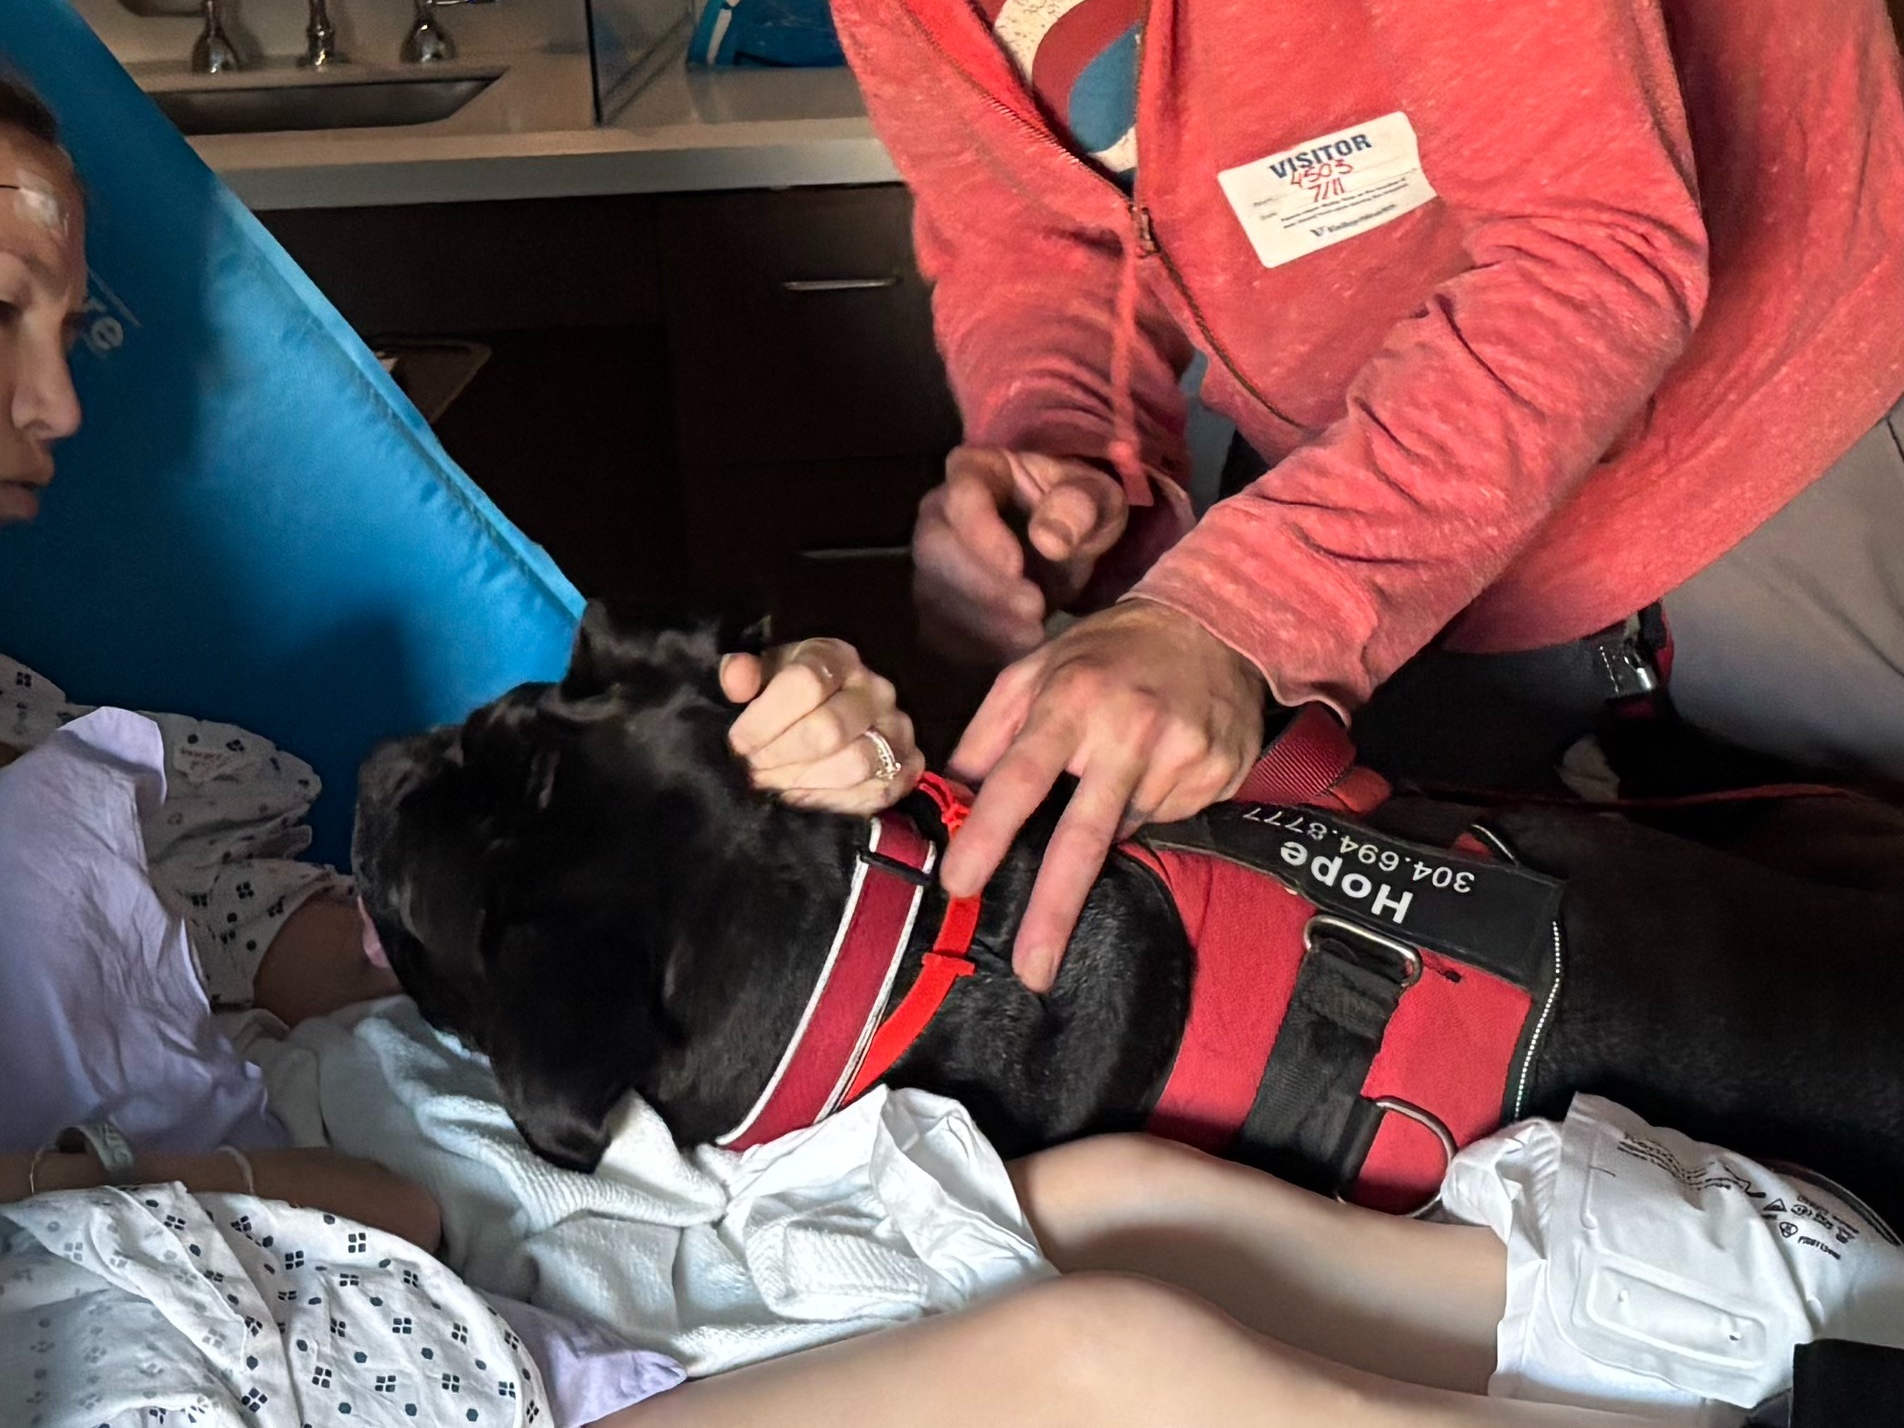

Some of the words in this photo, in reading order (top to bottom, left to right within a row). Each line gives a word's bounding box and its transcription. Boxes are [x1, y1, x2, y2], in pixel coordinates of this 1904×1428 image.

[1268, 133, 1373, 180] VISITOR
[1242, 805, 1476, 895] 304.694.8777
[1278, 839, 1414, 925] Hope
